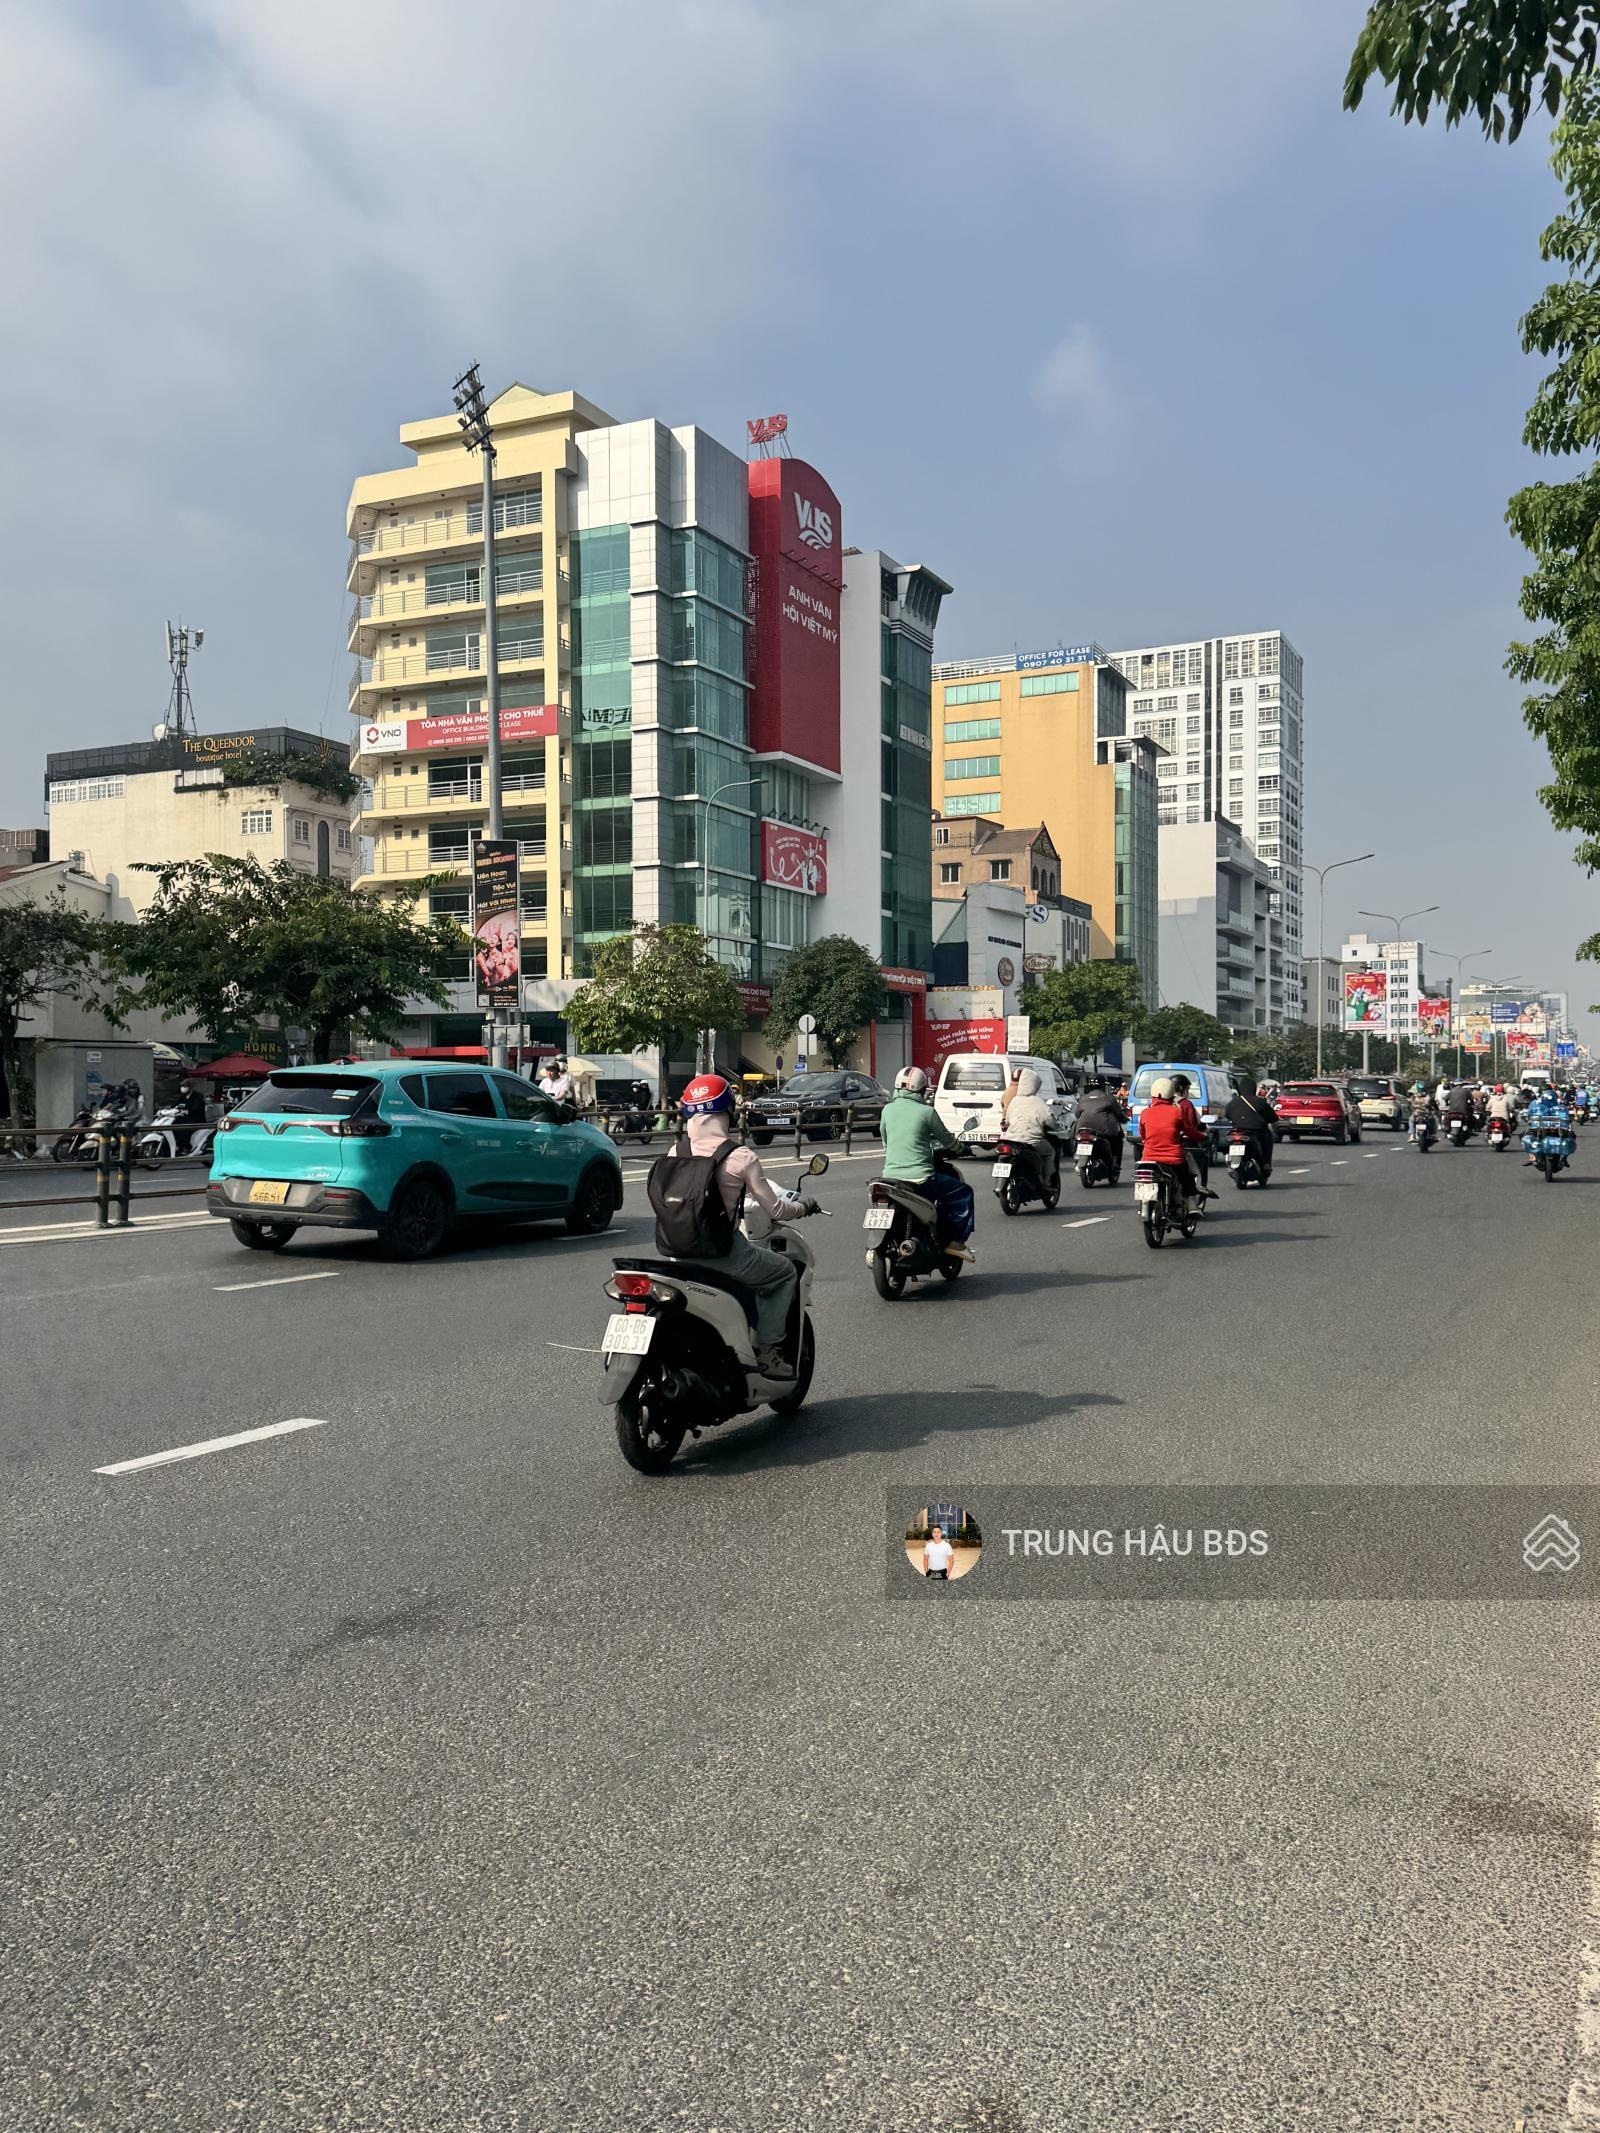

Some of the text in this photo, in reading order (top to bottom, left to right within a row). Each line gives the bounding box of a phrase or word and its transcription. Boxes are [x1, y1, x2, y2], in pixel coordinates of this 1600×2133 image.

[747, 414, 787, 437] VUS
[794, 491, 832, 544] VUS
[788, 585, 811, 604] ANH
[782, 603, 838, 644] HỘI VIỆT MỸ
[1018, 653, 1046, 662] OFFICE
[1066, 646, 1091, 656] LEASE
[1024, 660, 1047, 668] 0907
[421, 720, 436, 728] TÒA
[438, 718, 456, 727] NHÀ
[456, 716, 472, 724] VĂN
[504, 712, 521, 720] CHO
[522, 707, 544, 718] THUÊ
[182, 736, 256, 752] THE QUEENDOR
[196, 750, 242, 764] boutique hotel
